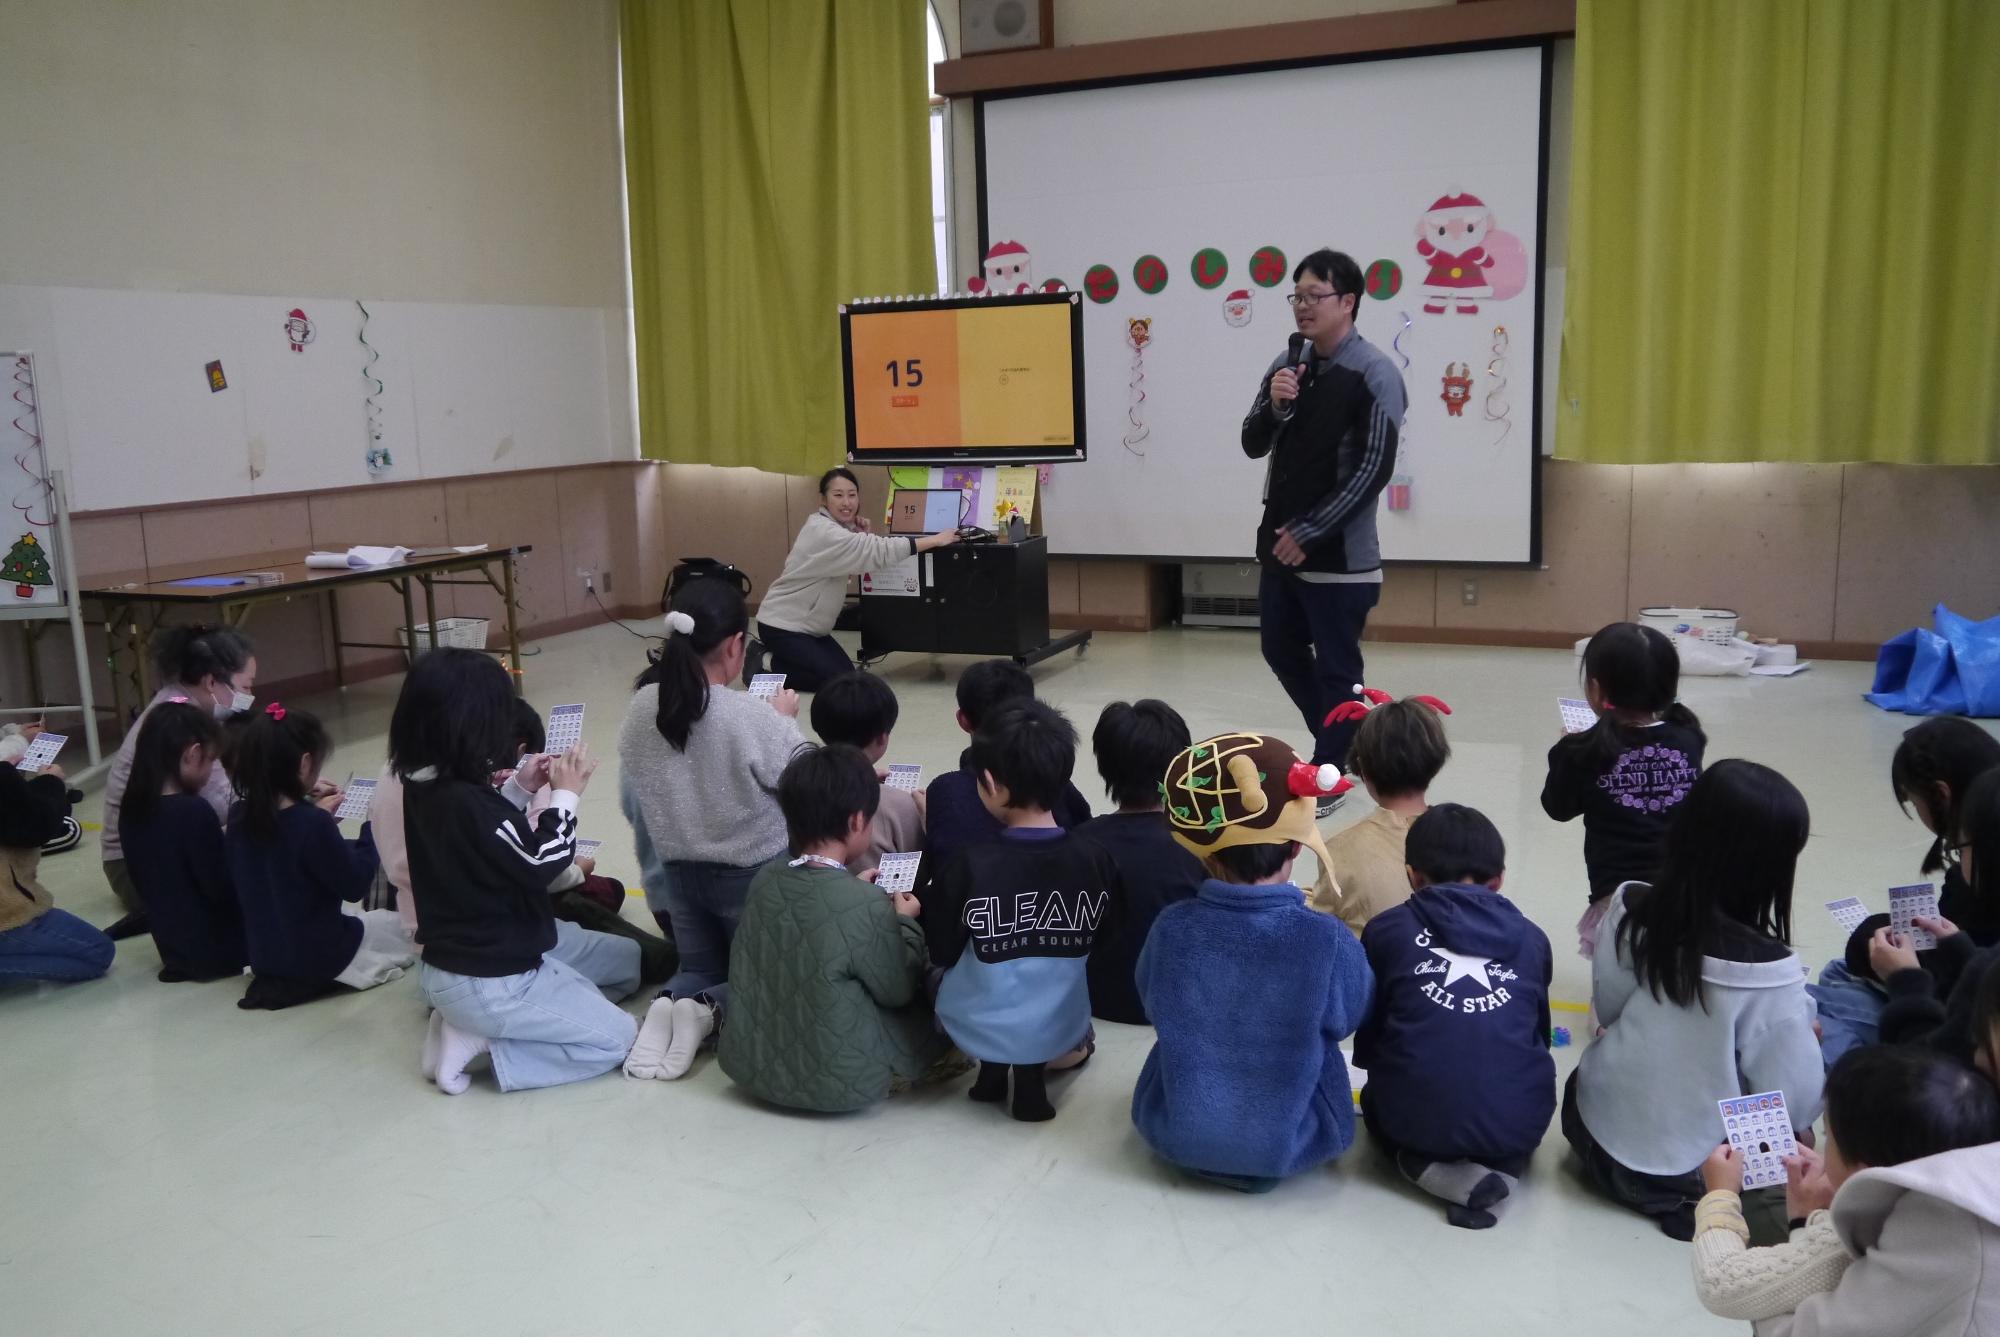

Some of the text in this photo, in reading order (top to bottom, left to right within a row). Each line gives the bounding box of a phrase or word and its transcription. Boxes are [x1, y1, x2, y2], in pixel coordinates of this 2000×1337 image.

[886, 359, 923, 387] 15
[904, 505, 916, 514] 15
[1629, 760, 1672, 771] YOU CAN
[1599, 772, 1648, 788] SPEND
[1653, 768, 1697, 784] HAPPY
[981, 935, 1093, 953] CLEAR SOUND
[1414, 959, 1519, 982] Chuck Taylor
[1420, 980, 1512, 1013] ALL STAR
